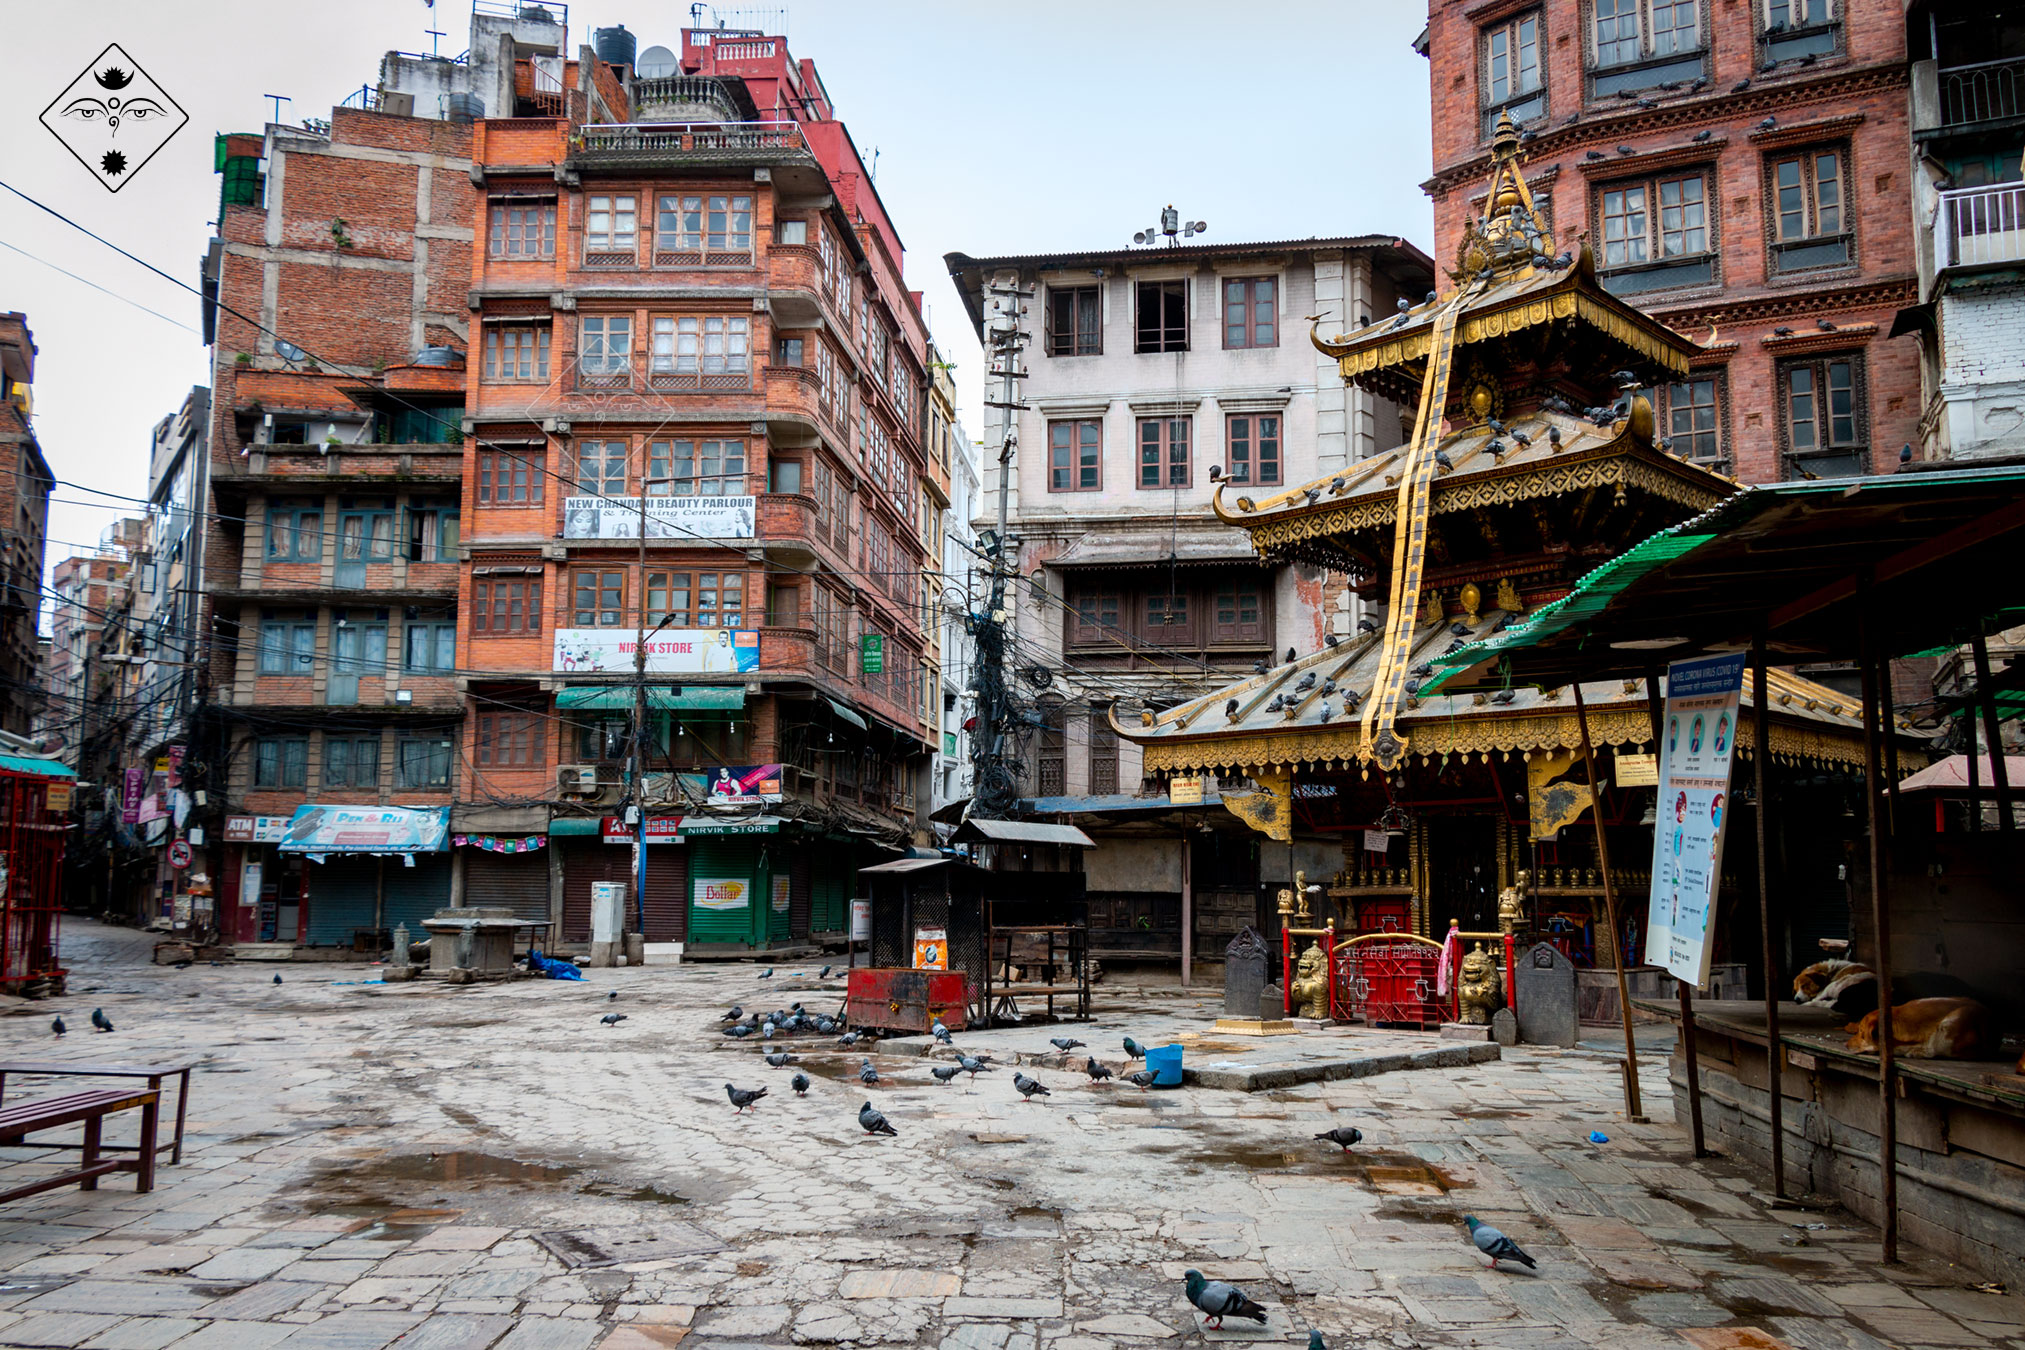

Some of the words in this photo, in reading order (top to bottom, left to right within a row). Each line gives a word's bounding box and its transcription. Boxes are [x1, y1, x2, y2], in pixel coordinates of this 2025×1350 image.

[568, 499, 594, 509] NEW
[657, 498, 700, 509] BEAUTY
[702, 498, 753, 508] PARLOUR
[658, 642, 693, 654] STORE
[364, 813, 378, 823] &
[228, 819, 252, 831] ATM
[688, 826, 724, 835] NIRVIK
[731, 825, 769, 833] STORE
[705, 885, 739, 900] Dollar
